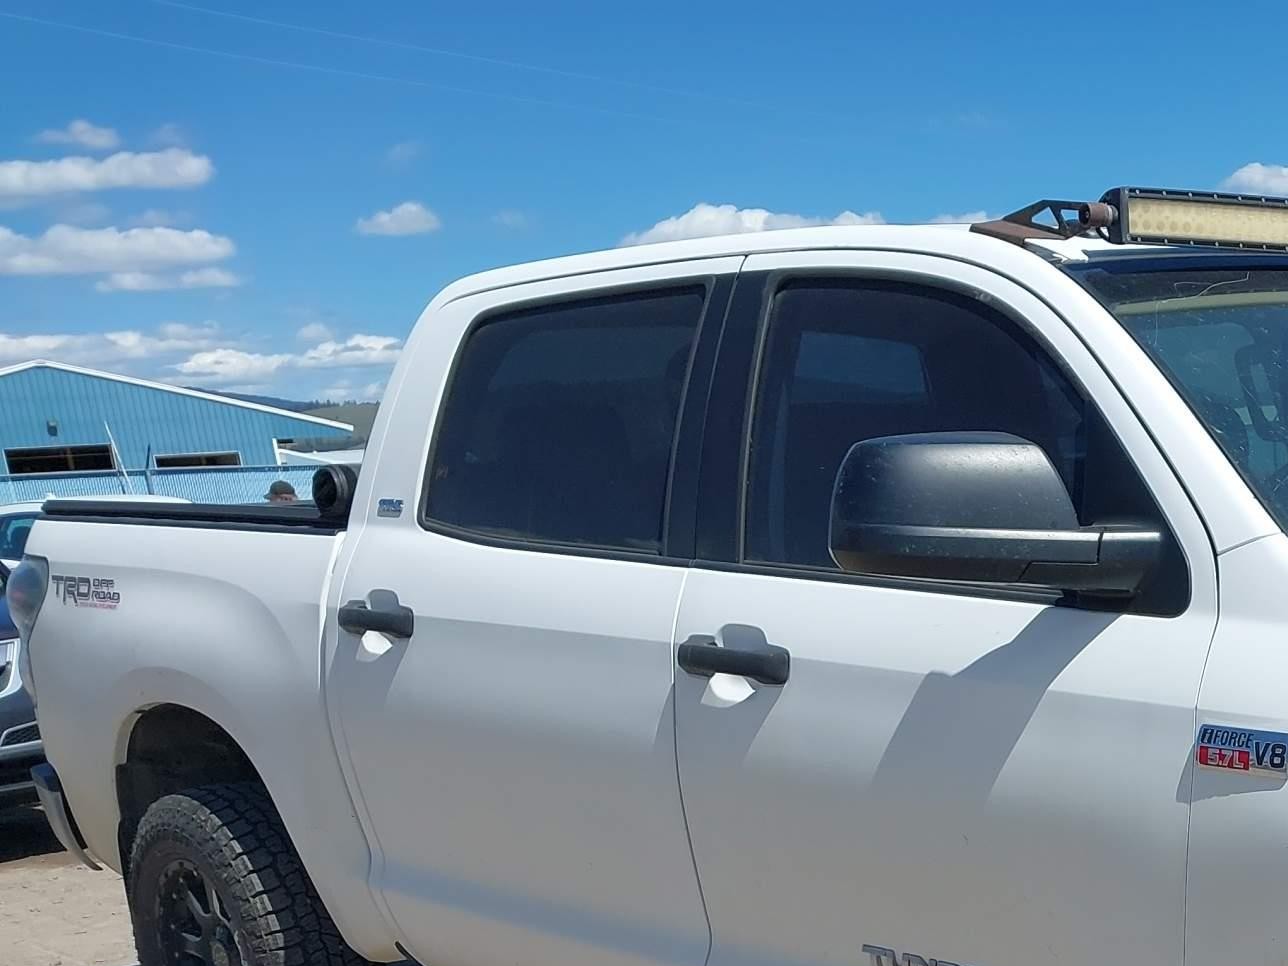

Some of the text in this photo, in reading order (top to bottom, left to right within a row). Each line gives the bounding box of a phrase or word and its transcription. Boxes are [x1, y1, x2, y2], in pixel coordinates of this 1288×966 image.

[51, 575, 91, 605] TRD
[93, 578, 115, 589] OFF
[92, 590, 121, 604] ROAD
[1207, 749, 1244, 768] 5.7L
[1254, 741, 1287, 769] V8
